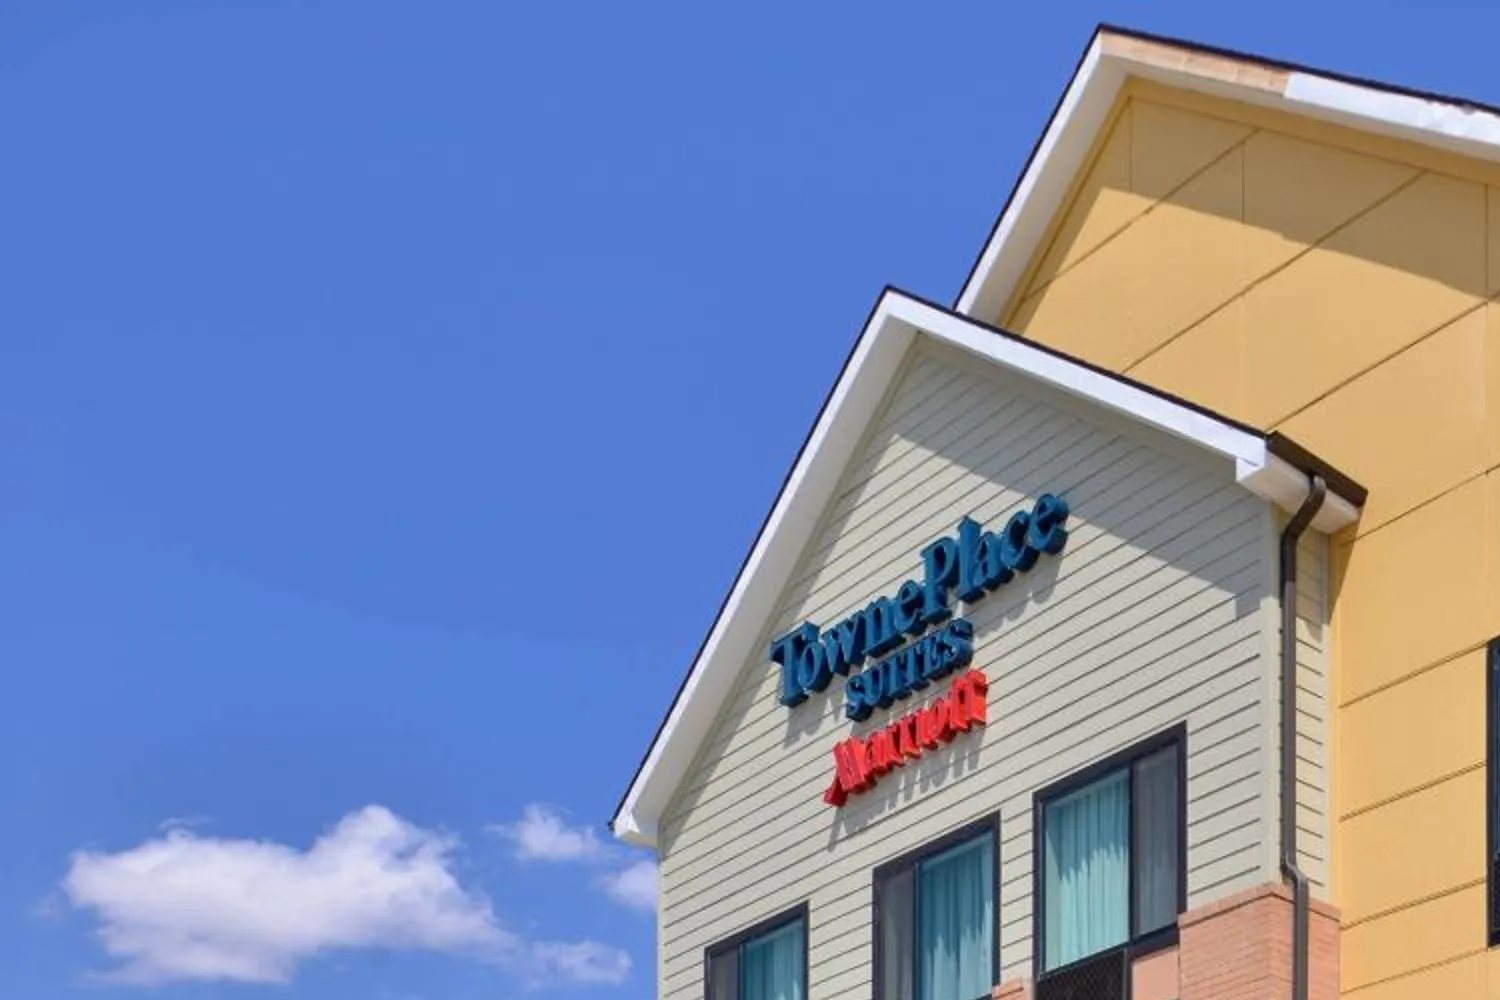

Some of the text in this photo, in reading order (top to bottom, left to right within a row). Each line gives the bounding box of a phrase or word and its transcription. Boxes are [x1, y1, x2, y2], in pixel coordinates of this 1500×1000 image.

[770, 493, 1069, 708] TownePlace
[845, 617, 974, 722] SUITES
[824, 669, 988, 807] Marriott
